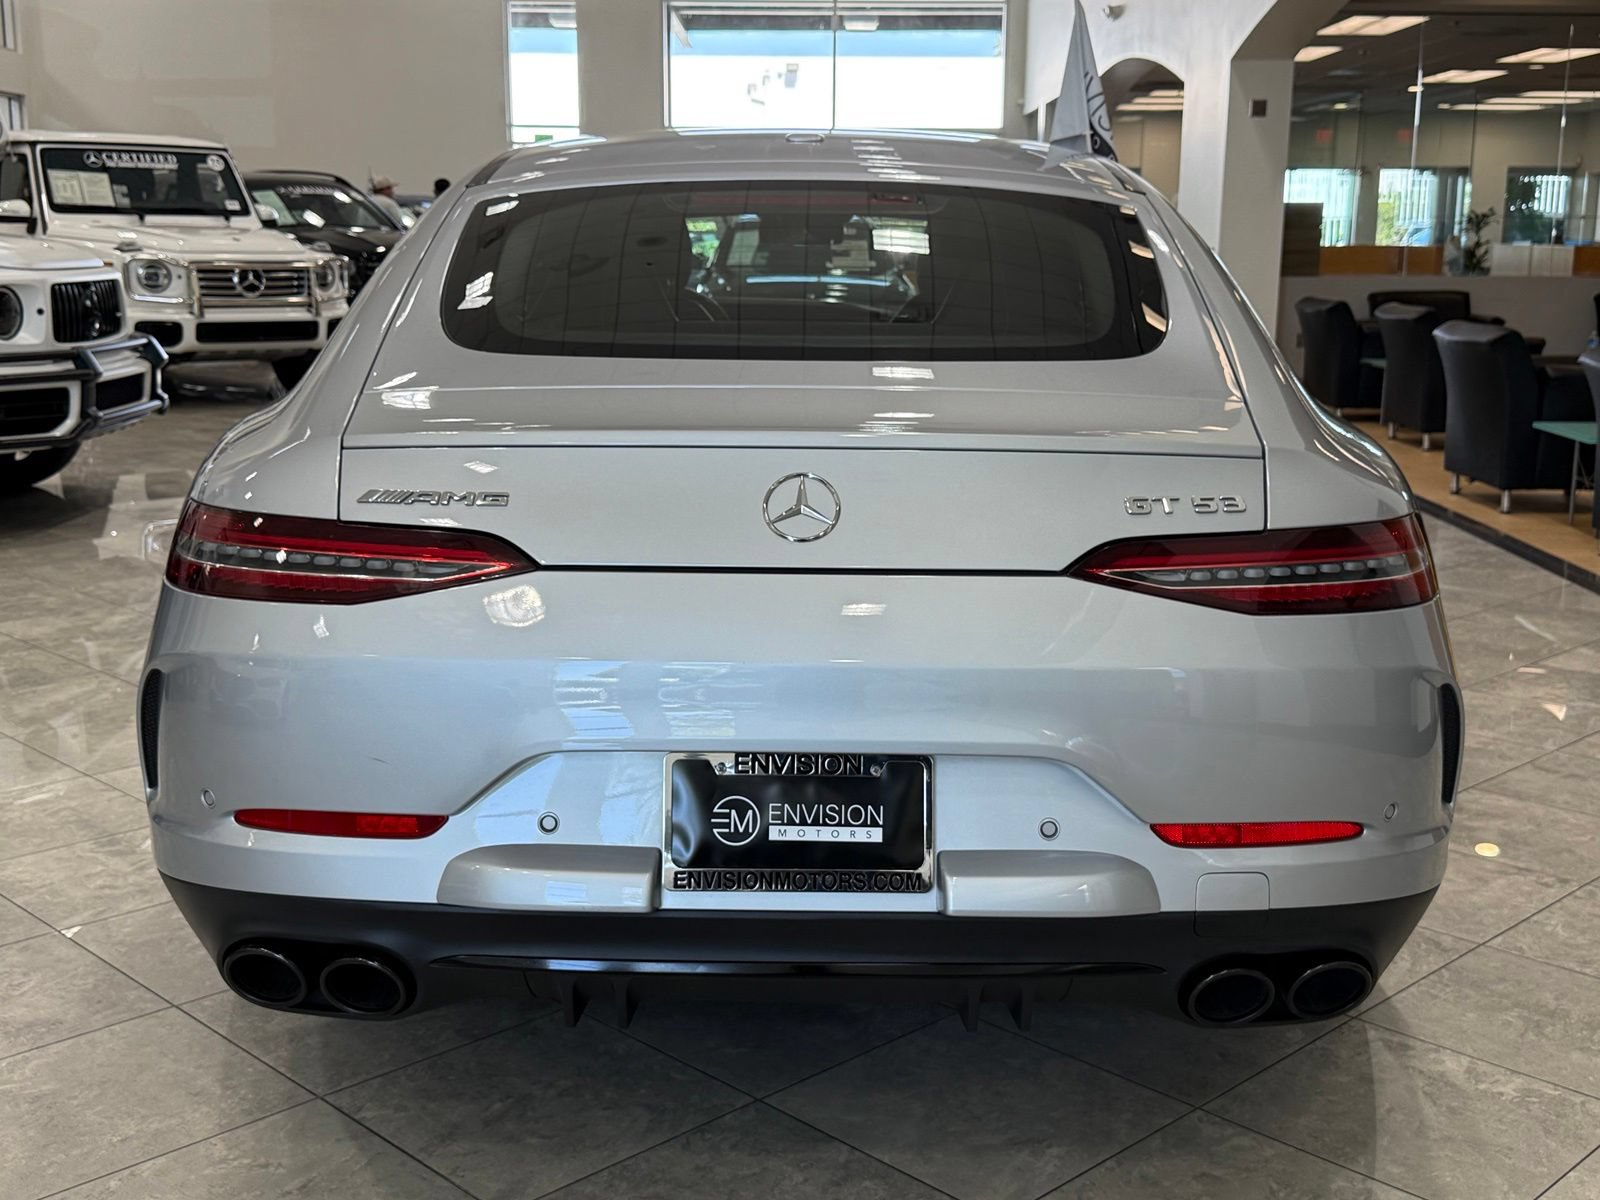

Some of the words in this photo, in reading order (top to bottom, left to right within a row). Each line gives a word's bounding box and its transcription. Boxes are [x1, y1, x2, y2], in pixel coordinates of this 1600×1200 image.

[403, 490, 510, 507] AMG
[1124, 496, 1180, 515] GT
[1191, 495, 1247, 514] 53
[734, 753, 864, 776] ENVISION
[768, 803, 884, 826] ENVISION
[778, 828, 873, 840] MOTORS
[672, 870, 923, 892] ENVISIONMOTORS.COM
